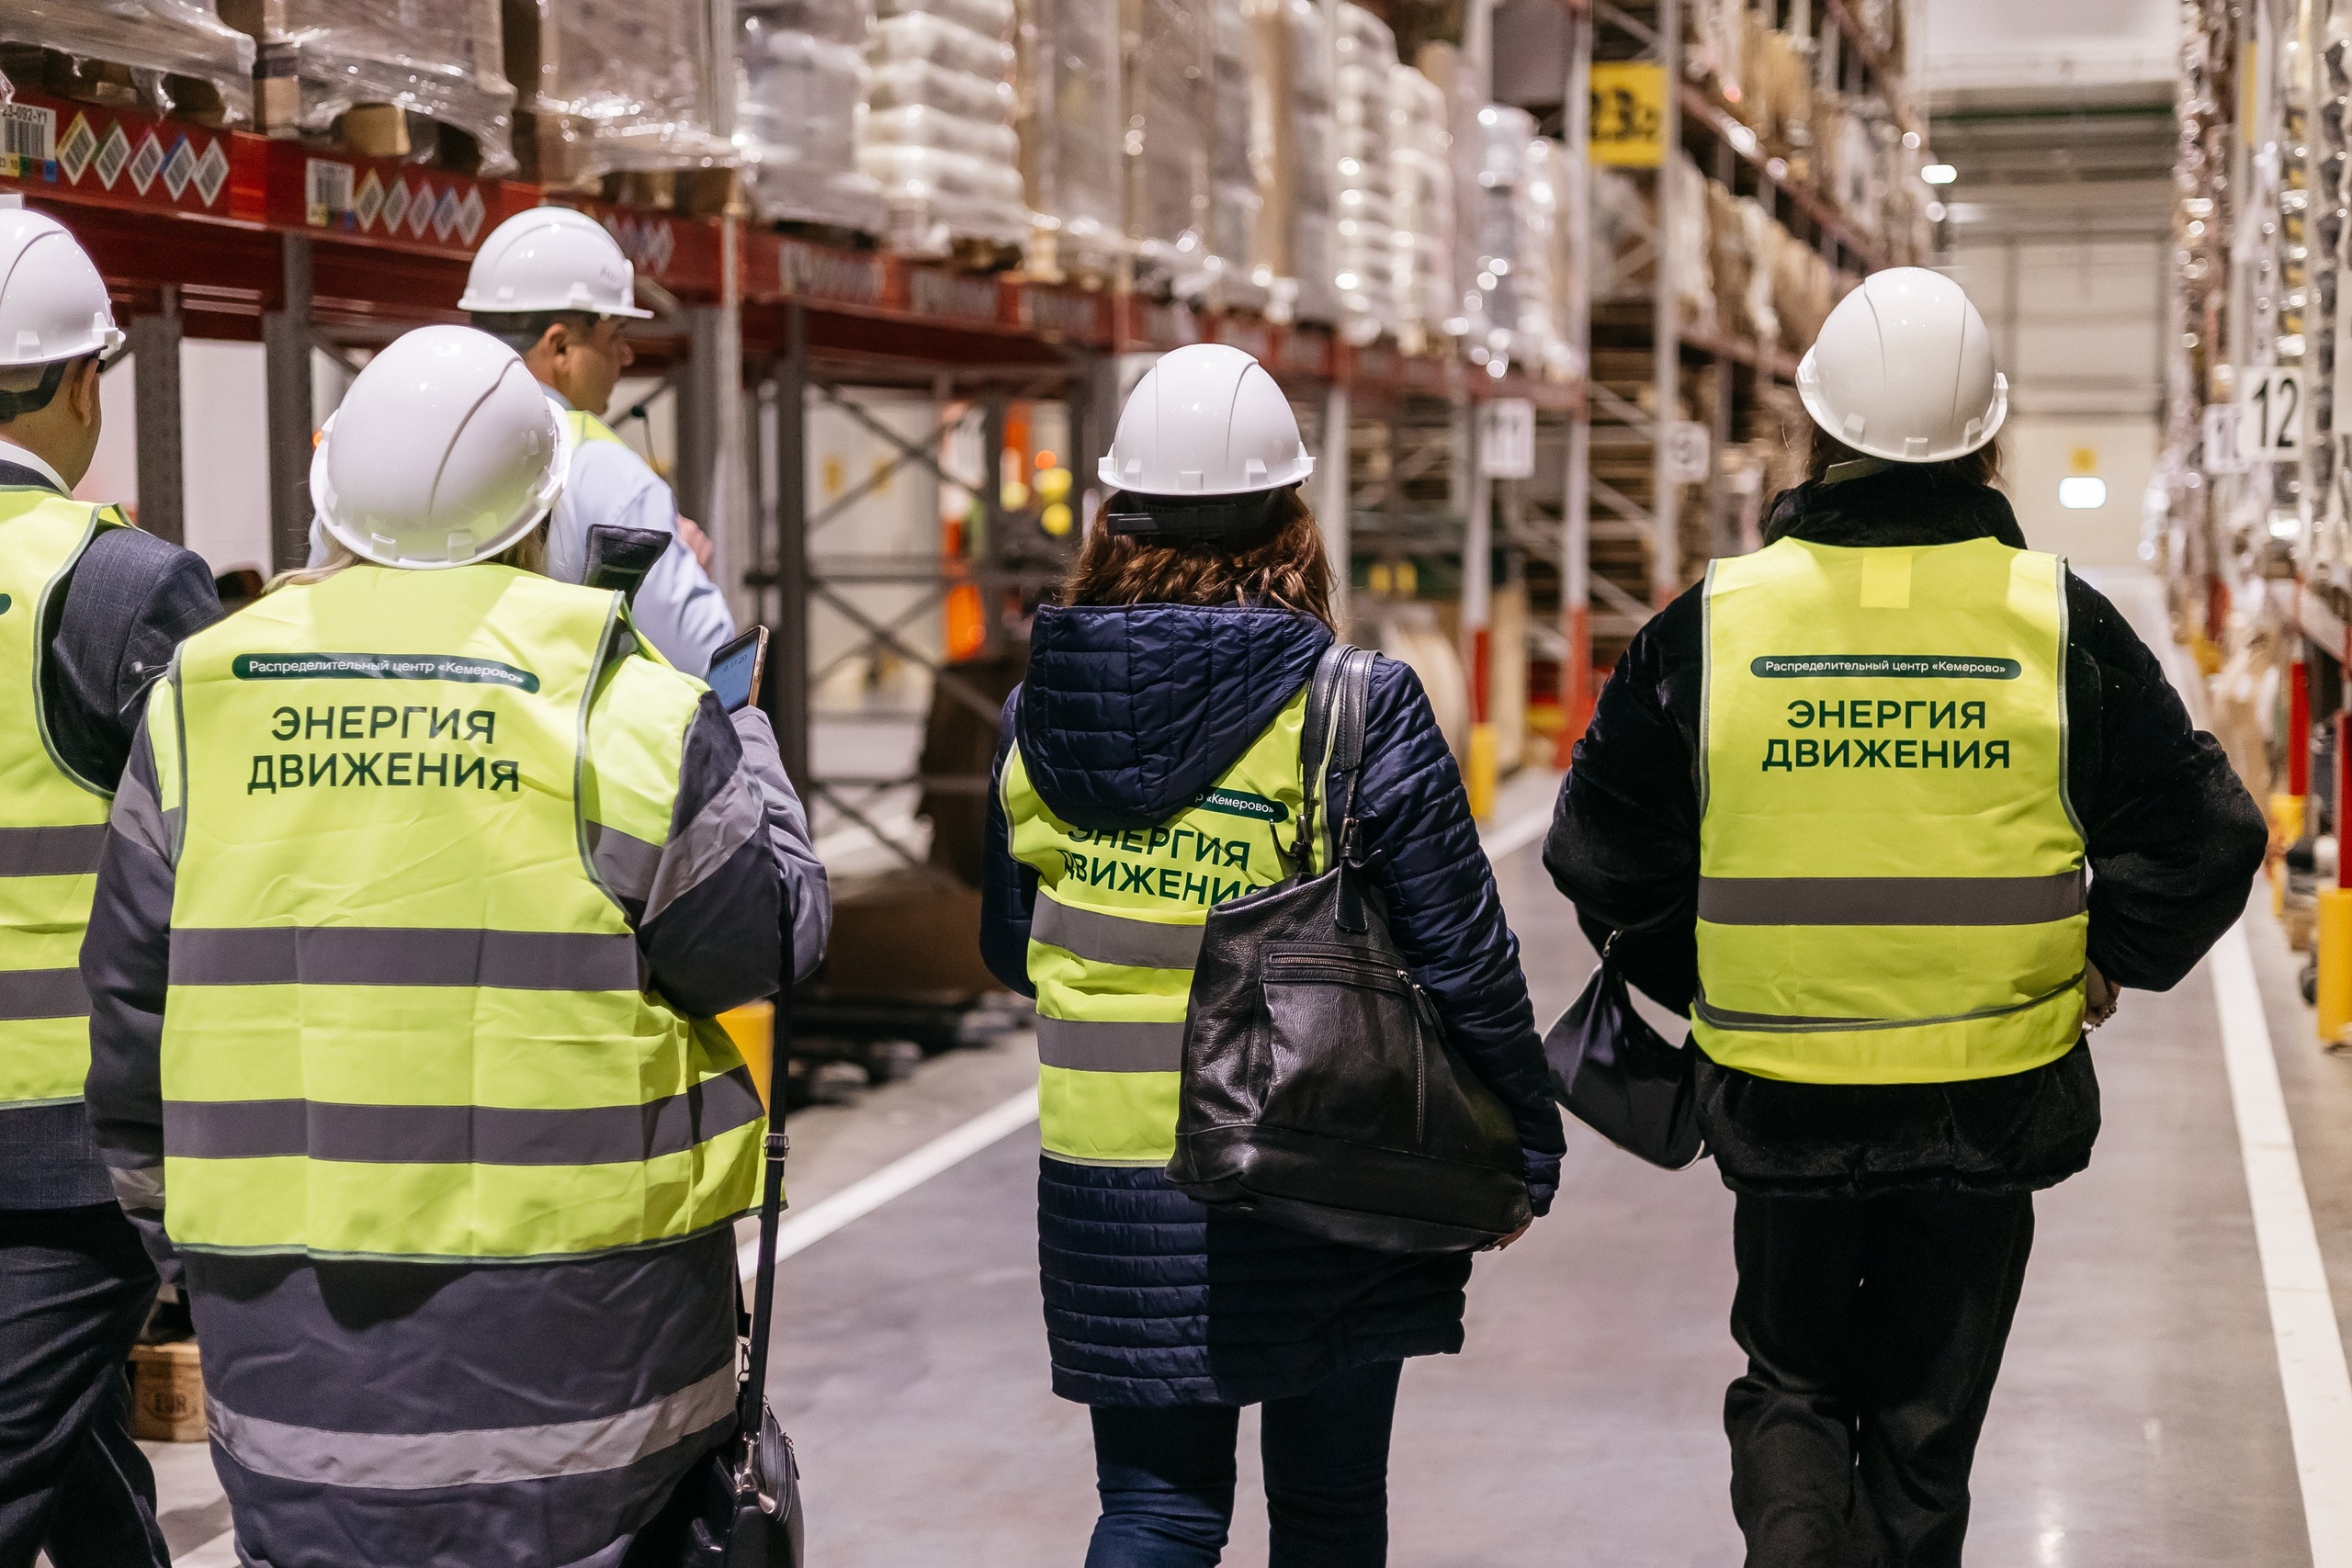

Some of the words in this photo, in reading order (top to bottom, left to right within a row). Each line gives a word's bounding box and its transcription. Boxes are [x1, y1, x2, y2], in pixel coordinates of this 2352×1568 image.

[2252, 378, 2297, 447] 12
[249, 660, 390, 674] Распределительный
[392, 660, 435, 675] центр
[438, 661, 525, 683] «Кемерово»
[1765, 660, 1889, 672] Распределительный
[1893, 661, 1929, 672] центр
[1932, 660, 2007, 673] «Кемерово»
[271, 705, 495, 744] ЭНЕРГИЯ
[1787, 700, 1985, 729] ЭНЕРГИЯ
[1762, 739, 2009, 772] ДВИЖЕНИЯ
[247, 751, 520, 795] ДВИЖЕНИЯ
[1206, 794, 1274, 813] «Кемерово»
